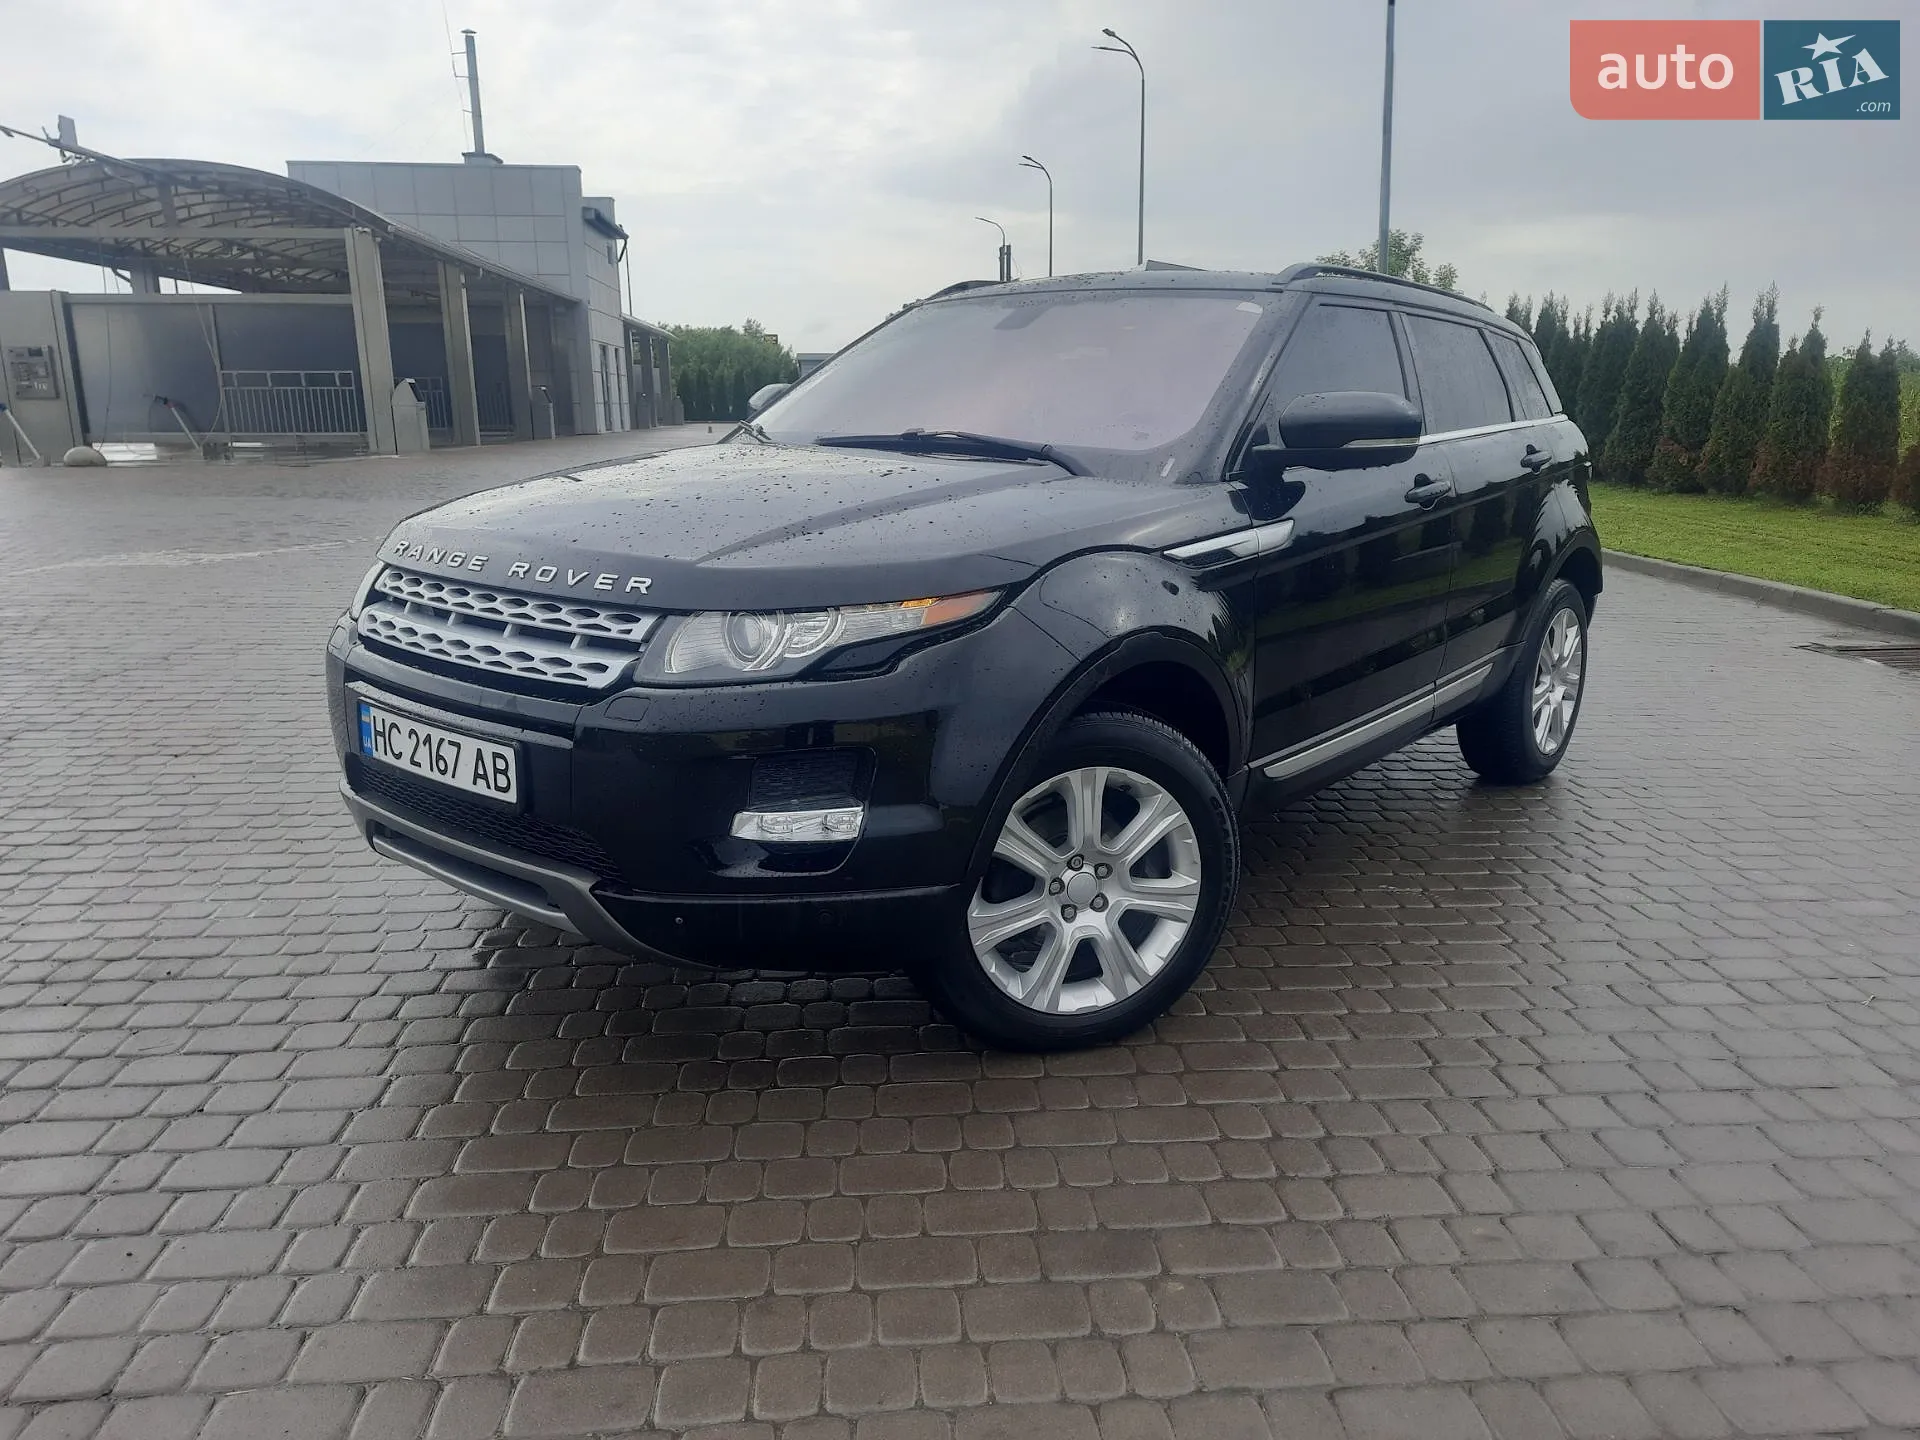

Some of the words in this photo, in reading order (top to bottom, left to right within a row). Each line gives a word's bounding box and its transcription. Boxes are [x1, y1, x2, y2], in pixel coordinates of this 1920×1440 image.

[393, 540, 489, 572] RANGE
[507, 561, 652, 595] ROVER
[363, 735, 372, 748] UA
[372, 715, 403, 760] HC
[408, 728, 462, 779] 2167
[472, 747, 512, 793] AB
